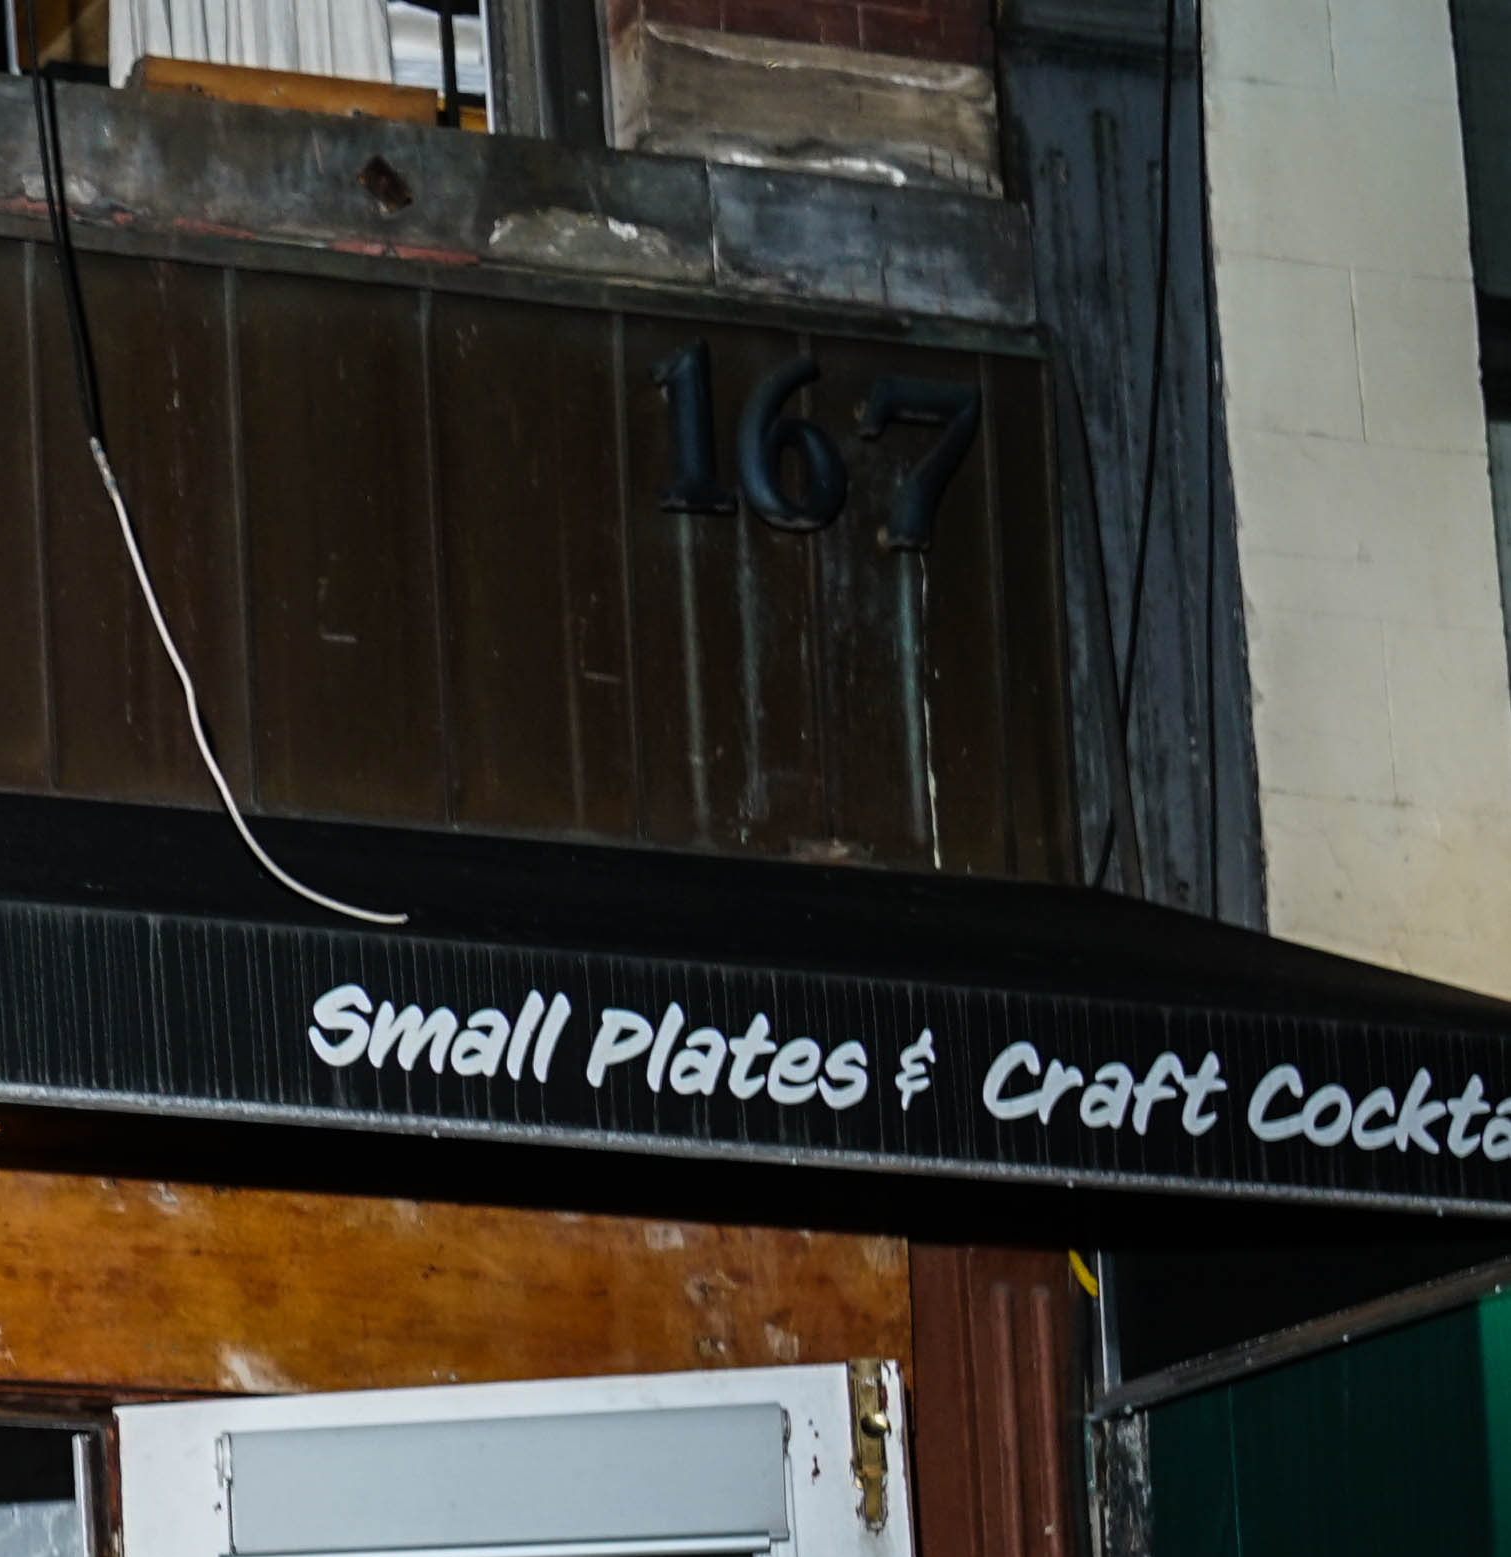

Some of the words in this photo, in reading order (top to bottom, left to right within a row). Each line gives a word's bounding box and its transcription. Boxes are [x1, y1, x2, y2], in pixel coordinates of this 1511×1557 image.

[648, 337, 984, 552] 167
[308, 983, 572, 1083] Small
[585, 1001, 870, 1112] Plates
[894, 1028, 937, 1111] &
[981, 1040, 1227, 1137] Craft
